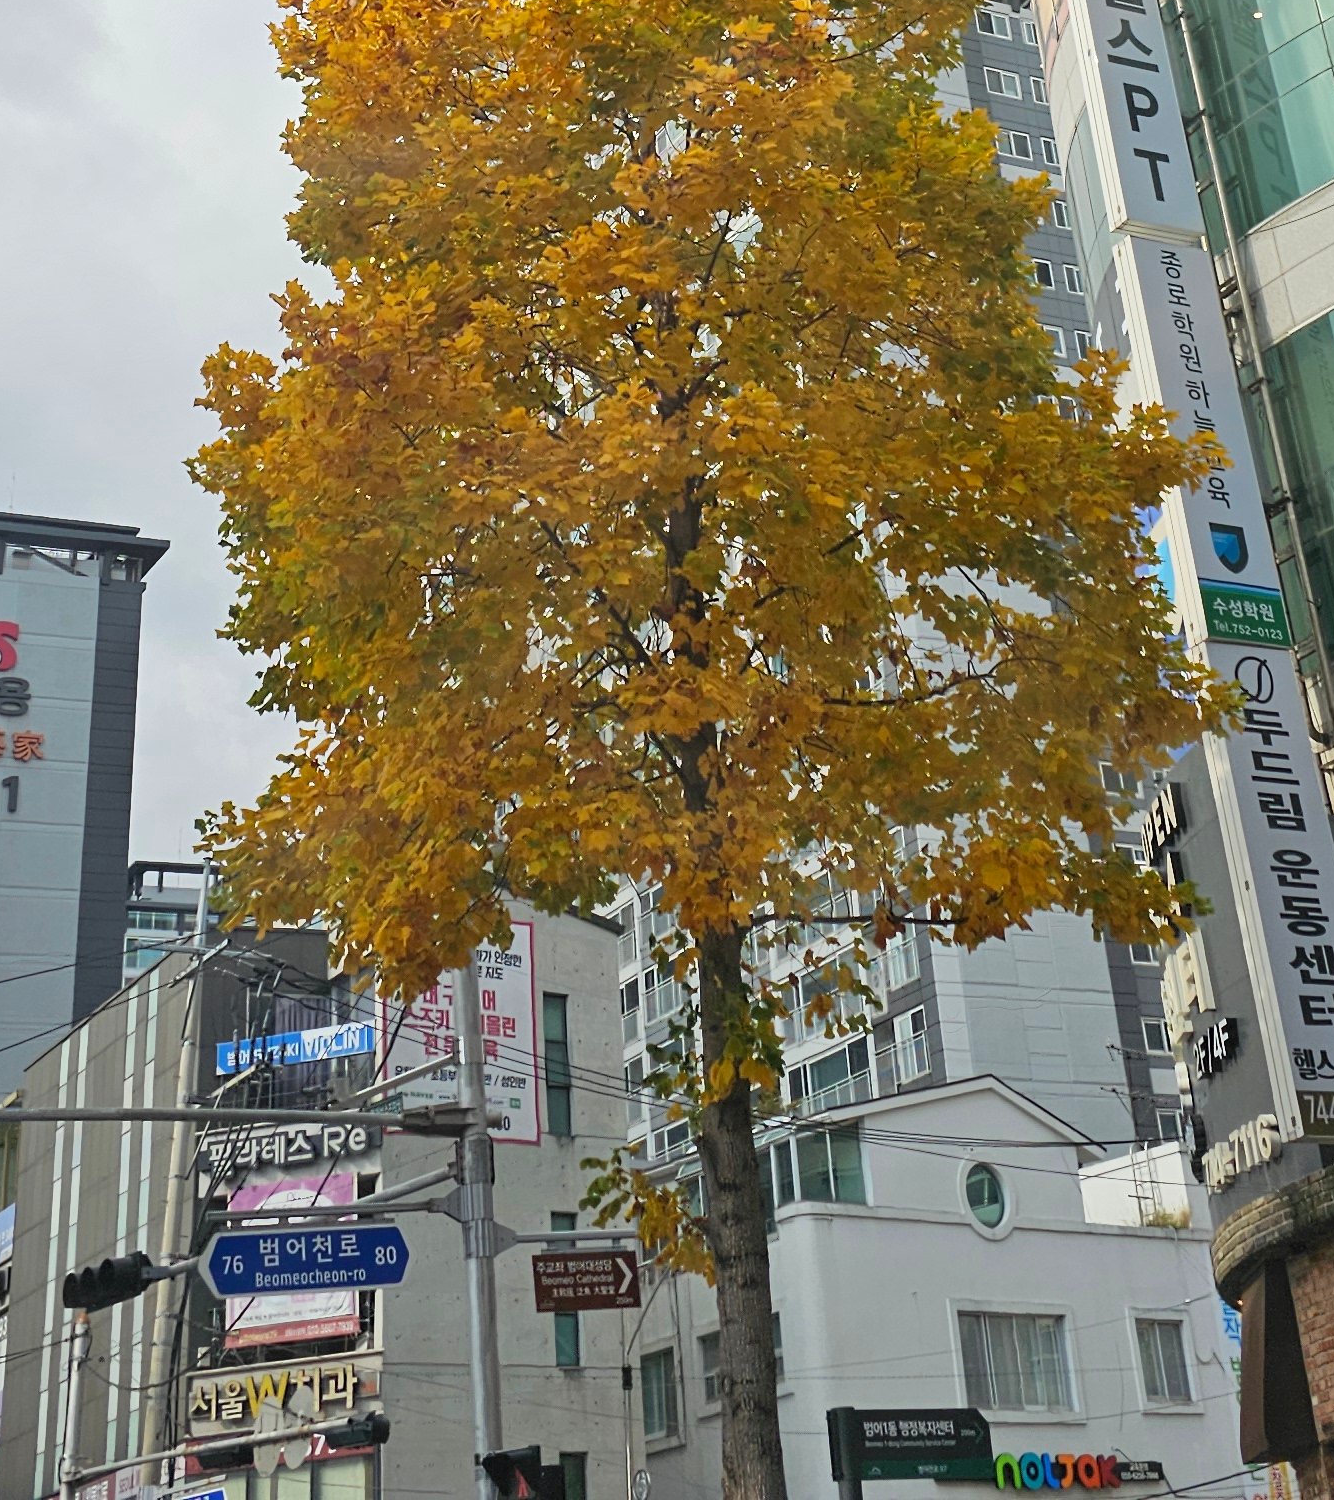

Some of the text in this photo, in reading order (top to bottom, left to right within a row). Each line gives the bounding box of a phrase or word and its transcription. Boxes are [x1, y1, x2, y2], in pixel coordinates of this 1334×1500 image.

[1213, 597, 1276, 623] 수성학원
[1243, 707, 1308, 833] 두드림
[1141, 783, 1178, 867] OPEN
[210, 1125, 368, 1177] 필라테스 Re
[222, 1233, 397, 1275] 76 범어천로 80
[255, 1268, 366, 1288] Beomeocheon-ro
